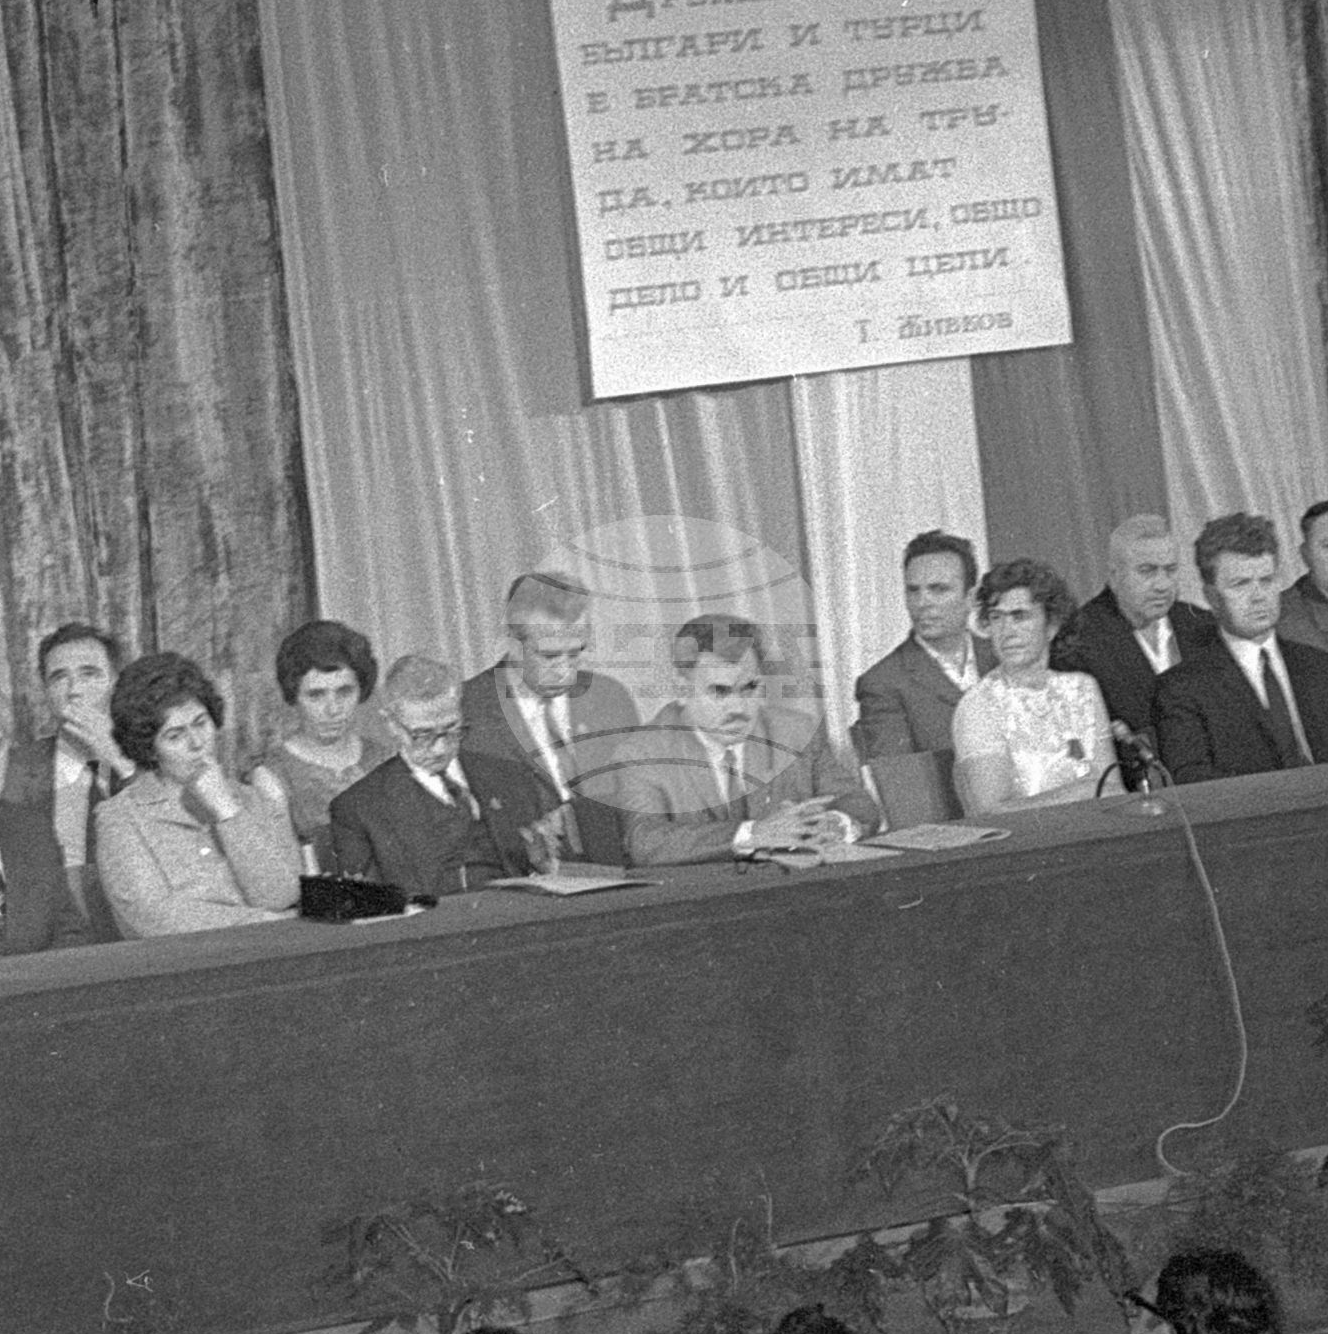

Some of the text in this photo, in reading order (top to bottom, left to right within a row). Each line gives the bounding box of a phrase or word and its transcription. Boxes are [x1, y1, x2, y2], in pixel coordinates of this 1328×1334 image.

[579, 9, 986, 67] БЪЛГАРИ И ТУРЦИ
[586, 55, 1011, 115] Е БРАТСКА ДРУЖБА
[591, 137, 650, 164] НА
[681, 123, 802, 156] ХОРА
[827, 114, 892, 142] НА
[832, 156, 958, 191] ИМАТ
[603, 195, 1042, 262] ОБЩИ ИНТЕРЕСИ, ОБЩО
[607, 280, 702, 317] ДЕЛО
[719, 274, 751, 299] И
[774, 259, 882, 293] ОБЩИ
